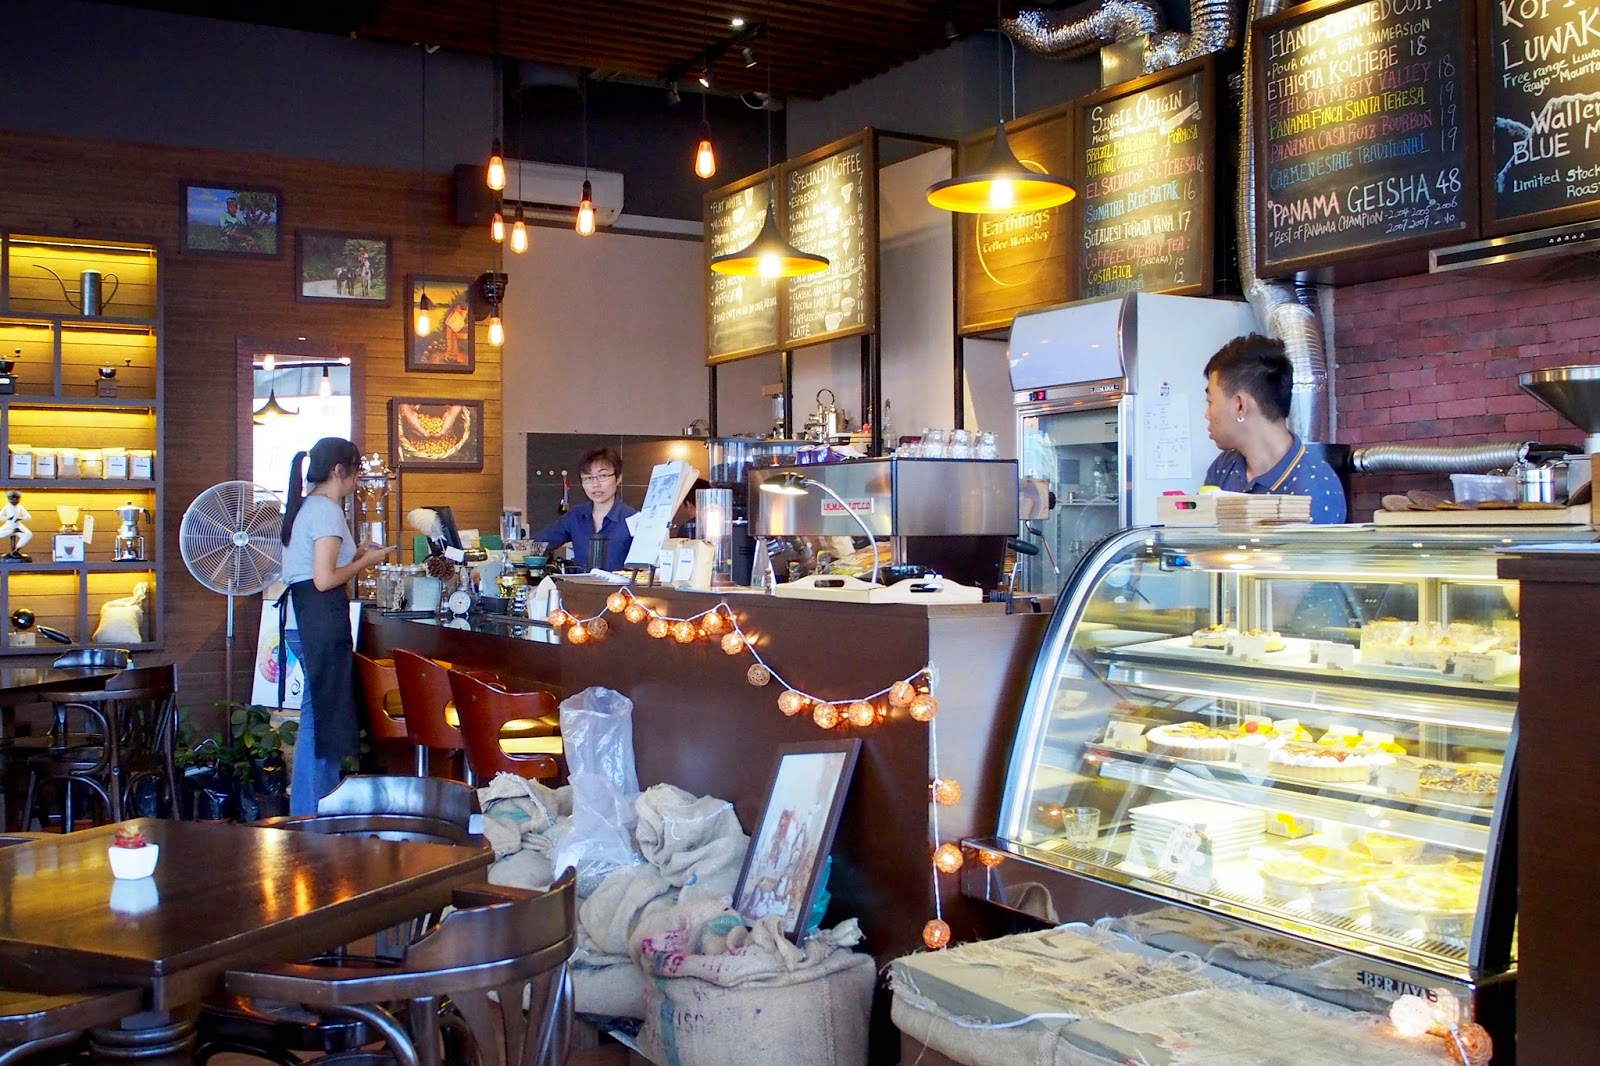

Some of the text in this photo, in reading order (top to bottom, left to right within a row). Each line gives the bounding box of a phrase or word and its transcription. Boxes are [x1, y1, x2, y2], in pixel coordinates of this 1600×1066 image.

[1366, 18, 1430, 46] IMMERSION
[1501, 7, 1600, 70] LUWAK
[1268, 67, 1324, 101] ETHIOPIA
[1410, 35, 1428, 56] 18
[1503, 72, 1531, 89] Free
[1533, 60, 1568, 79] range
[1269, 54, 1455, 119] ETHIOPIA MISTY VALLEY 18
[1092, 90, 1182, 133] SINGLE ORIGIN
[1269, 81, 1454, 141] PANAMA FINCA SANTA TERESA 19
[1270, 104, 1456, 164] PANAMA CASA RUIZ BOURBON 19
[1356, 133, 1429, 165] TRADITIONAL
[1441, 126, 1457, 152] 19
[1513, 132, 1570, 165] BLUE
[791, 153, 861, 194] SPECIALTY COFFEE
[1086, 181, 1100, 199] EL
[1102, 168, 1143, 195] SALVADOR
[1162, 156, 1196, 179] TERESA
[1513, 169, 1560, 193] Limited
[791, 189, 818, 209] ESPRESSO
[858, 171, 864, 184] 7
[858, 186, 863, 198] 9
[1087, 200, 1125, 223] SUMATRA
[1127, 189, 1149, 212] BLUE
[1184, 179, 1196, 201] 16
[1273, 168, 1461, 228] PANAMA GEISHA 48
[1567, 182, 1600, 198] Roas
[712, 200, 725, 215] FLAT
[858, 213, 864, 226] 9
[1274, 228, 1292, 247] BEST
[1303, 220, 1336, 242] PANAMA
[1338, 211, 1384, 232] CHAMPION
[1436, 196, 1457, 210] 2006
[983, 210, 1050, 238] Earthlings
[1084, 224, 1122, 249] SULAWESI
[1179, 210, 1191, 231] 17
[1386, 219, 1408, 234] 2007
[858, 253, 865, 265] 15
[983, 240, 1008, 254] Coffee
[1085, 249, 1125, 270] COFFEE
[1127, 240, 1165, 261] CHERRY
[858, 273, 863, 287] 8
[1088, 257, 1185, 285] COSTA RICA 10
[1174, 272, 1185, 283] 12
[858, 288, 865, 298] 10
[858, 300, 864, 310] 11
[858, 313, 864, 323] 11
